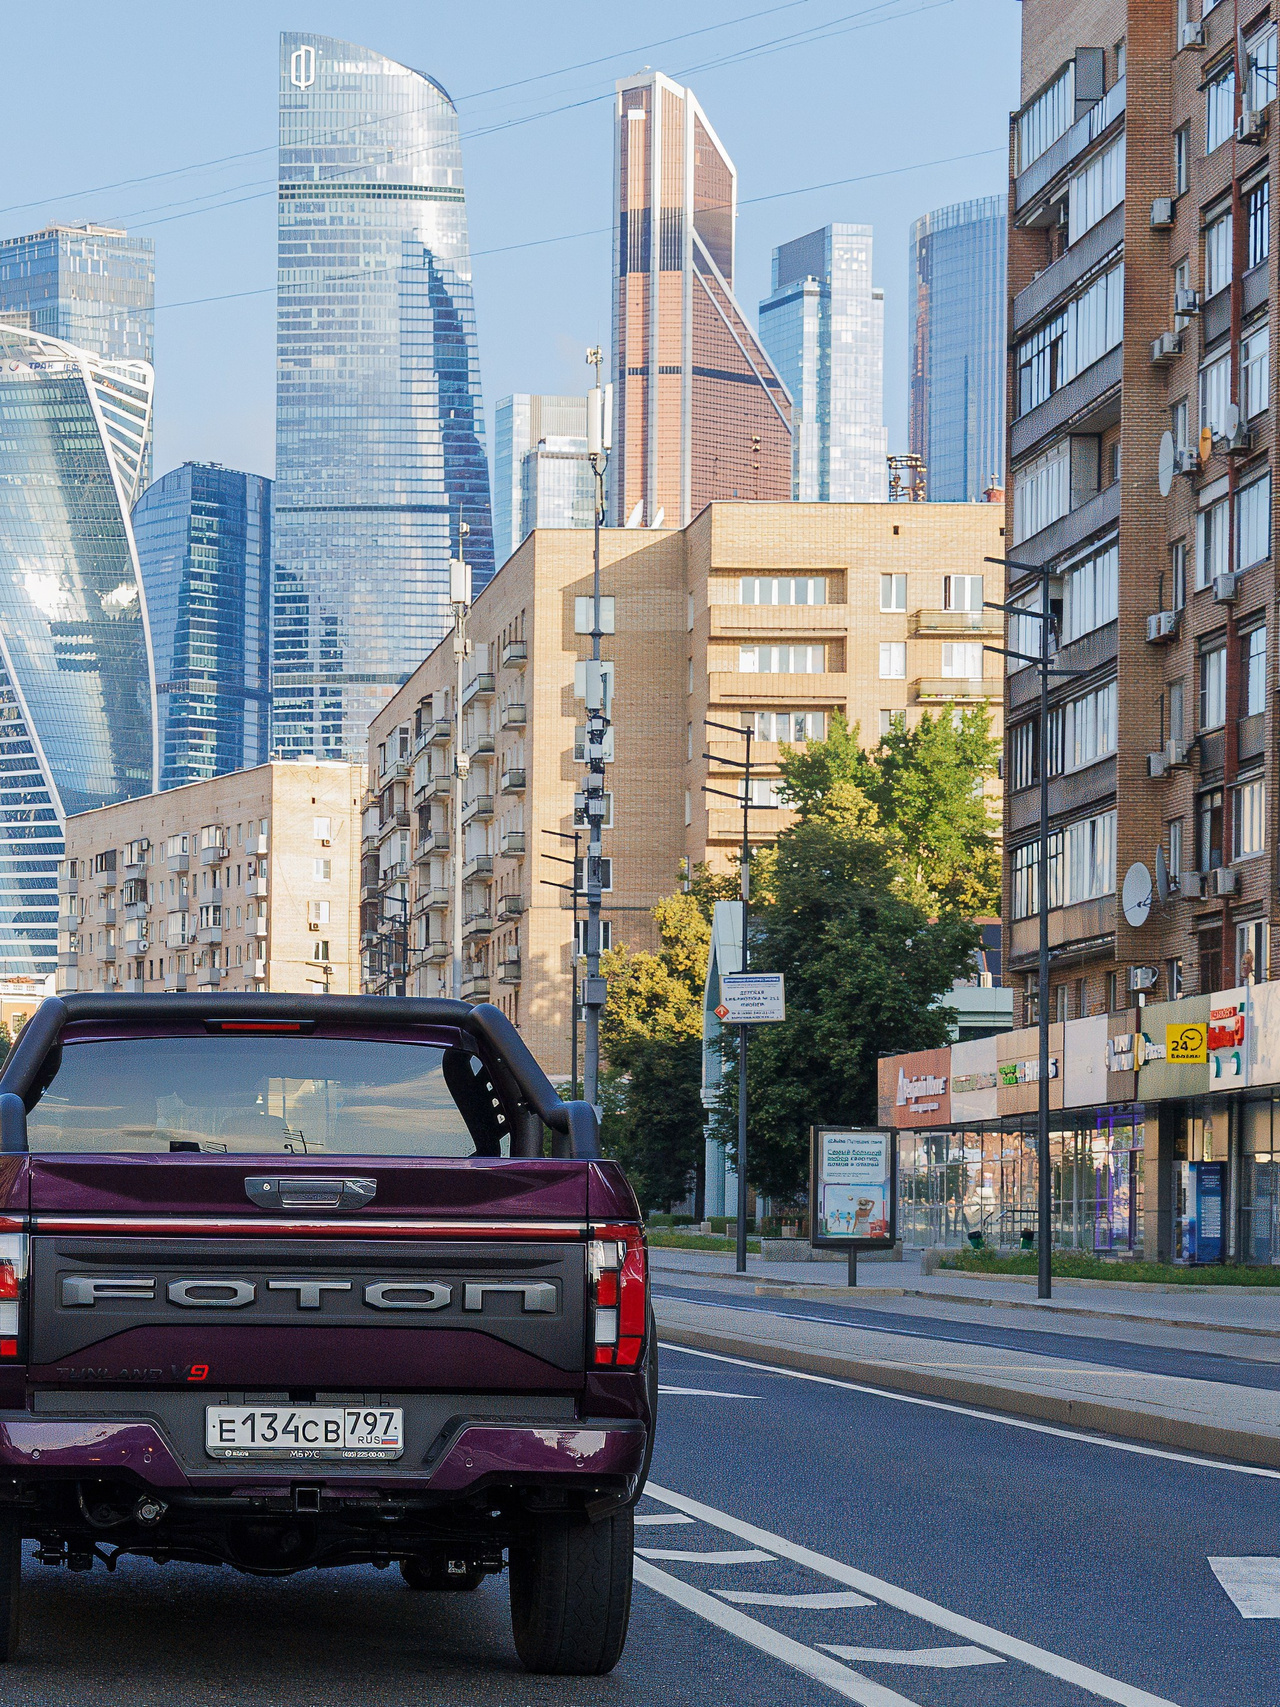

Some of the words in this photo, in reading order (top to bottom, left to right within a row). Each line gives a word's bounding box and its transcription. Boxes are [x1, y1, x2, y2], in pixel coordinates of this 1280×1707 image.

[1171, 1041, 1188, 1051] 24
[62, 1277, 557, 1312] FOTON
[56, 1367, 163, 1380] TUNLAND
[170, 1364, 209, 1381] V9
[346, 1411, 395, 1436] 797
[357, 1435, 380, 1445] RUS
